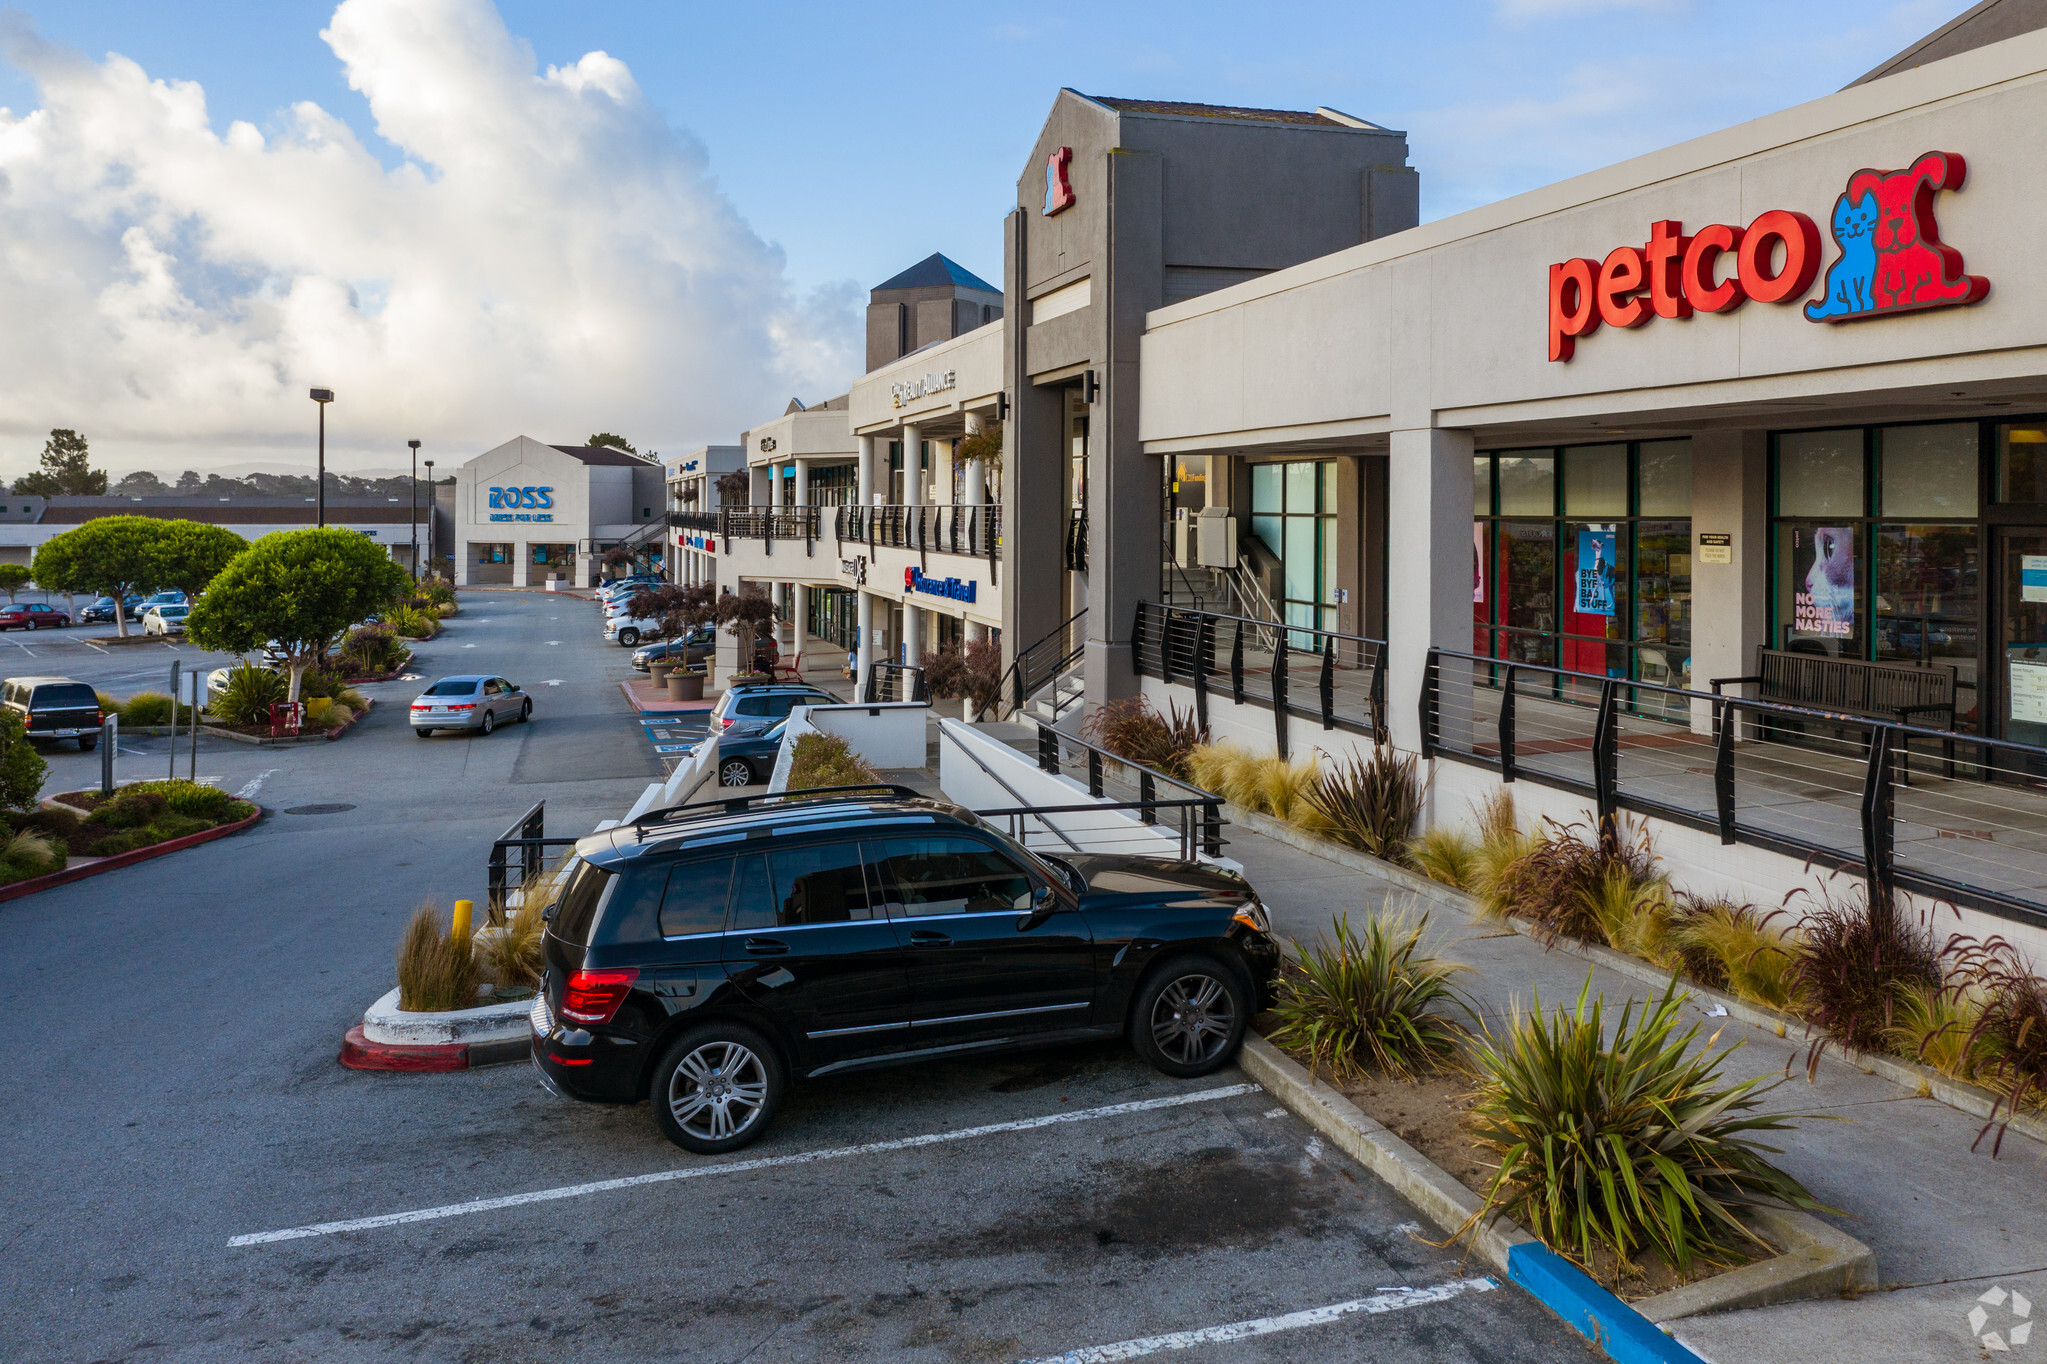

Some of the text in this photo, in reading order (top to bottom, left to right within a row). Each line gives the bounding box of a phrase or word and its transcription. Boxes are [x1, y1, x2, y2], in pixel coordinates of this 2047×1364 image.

[1549, 209, 1822, 362] petco
[488, 486, 553, 509] ROSS
[515, 513, 531, 522] FOR
[533, 513, 553, 522] LESS
[1581, 569, 1598, 579] BYE
[916, 571, 944, 596] Insurance
[951, 578, 977, 603] Travel
[1581, 579, 1598, 588] BYE
[1581, 589, 1599, 598] BAD
[1795, 592, 1815, 605] NO
[1581, 599, 1607, 609] STUFF
[1795, 605, 1833, 619] MORE
[1795, 618, 1851, 634] NASTIES
